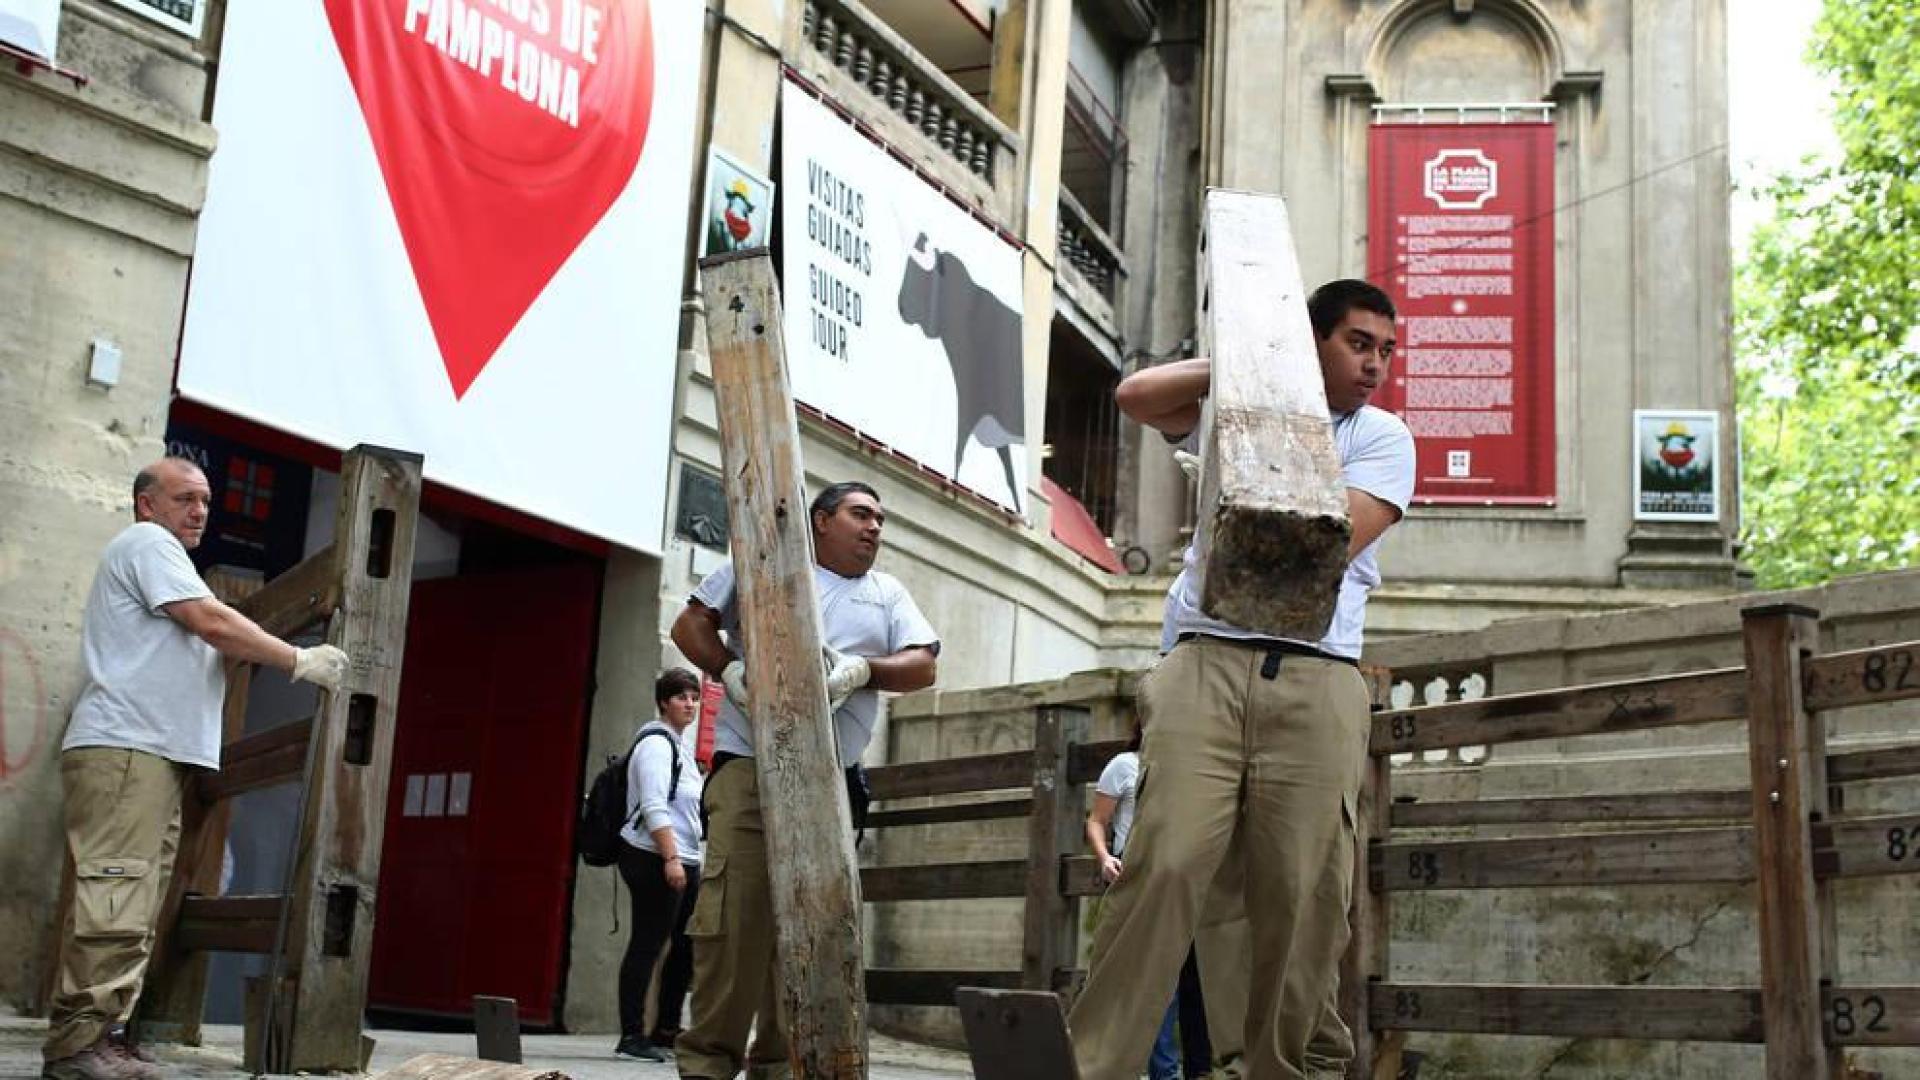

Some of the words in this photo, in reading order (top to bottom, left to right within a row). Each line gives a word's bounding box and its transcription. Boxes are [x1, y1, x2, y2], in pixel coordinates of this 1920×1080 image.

[560, 0, 600, 64] DE
[404, 0, 579, 128] PAMPLONA
[808, 158, 864, 229] VISITAS
[808, 203, 871, 276] GUIADAS
[810, 262, 862, 327] GUIDED
[811, 307, 849, 363] TOUR
[1862, 650, 1920, 693] 82
[1391, 715, 1416, 740] 83
[1395, 990, 1422, 1019] 83
[1833, 996, 1891, 1035] 82
